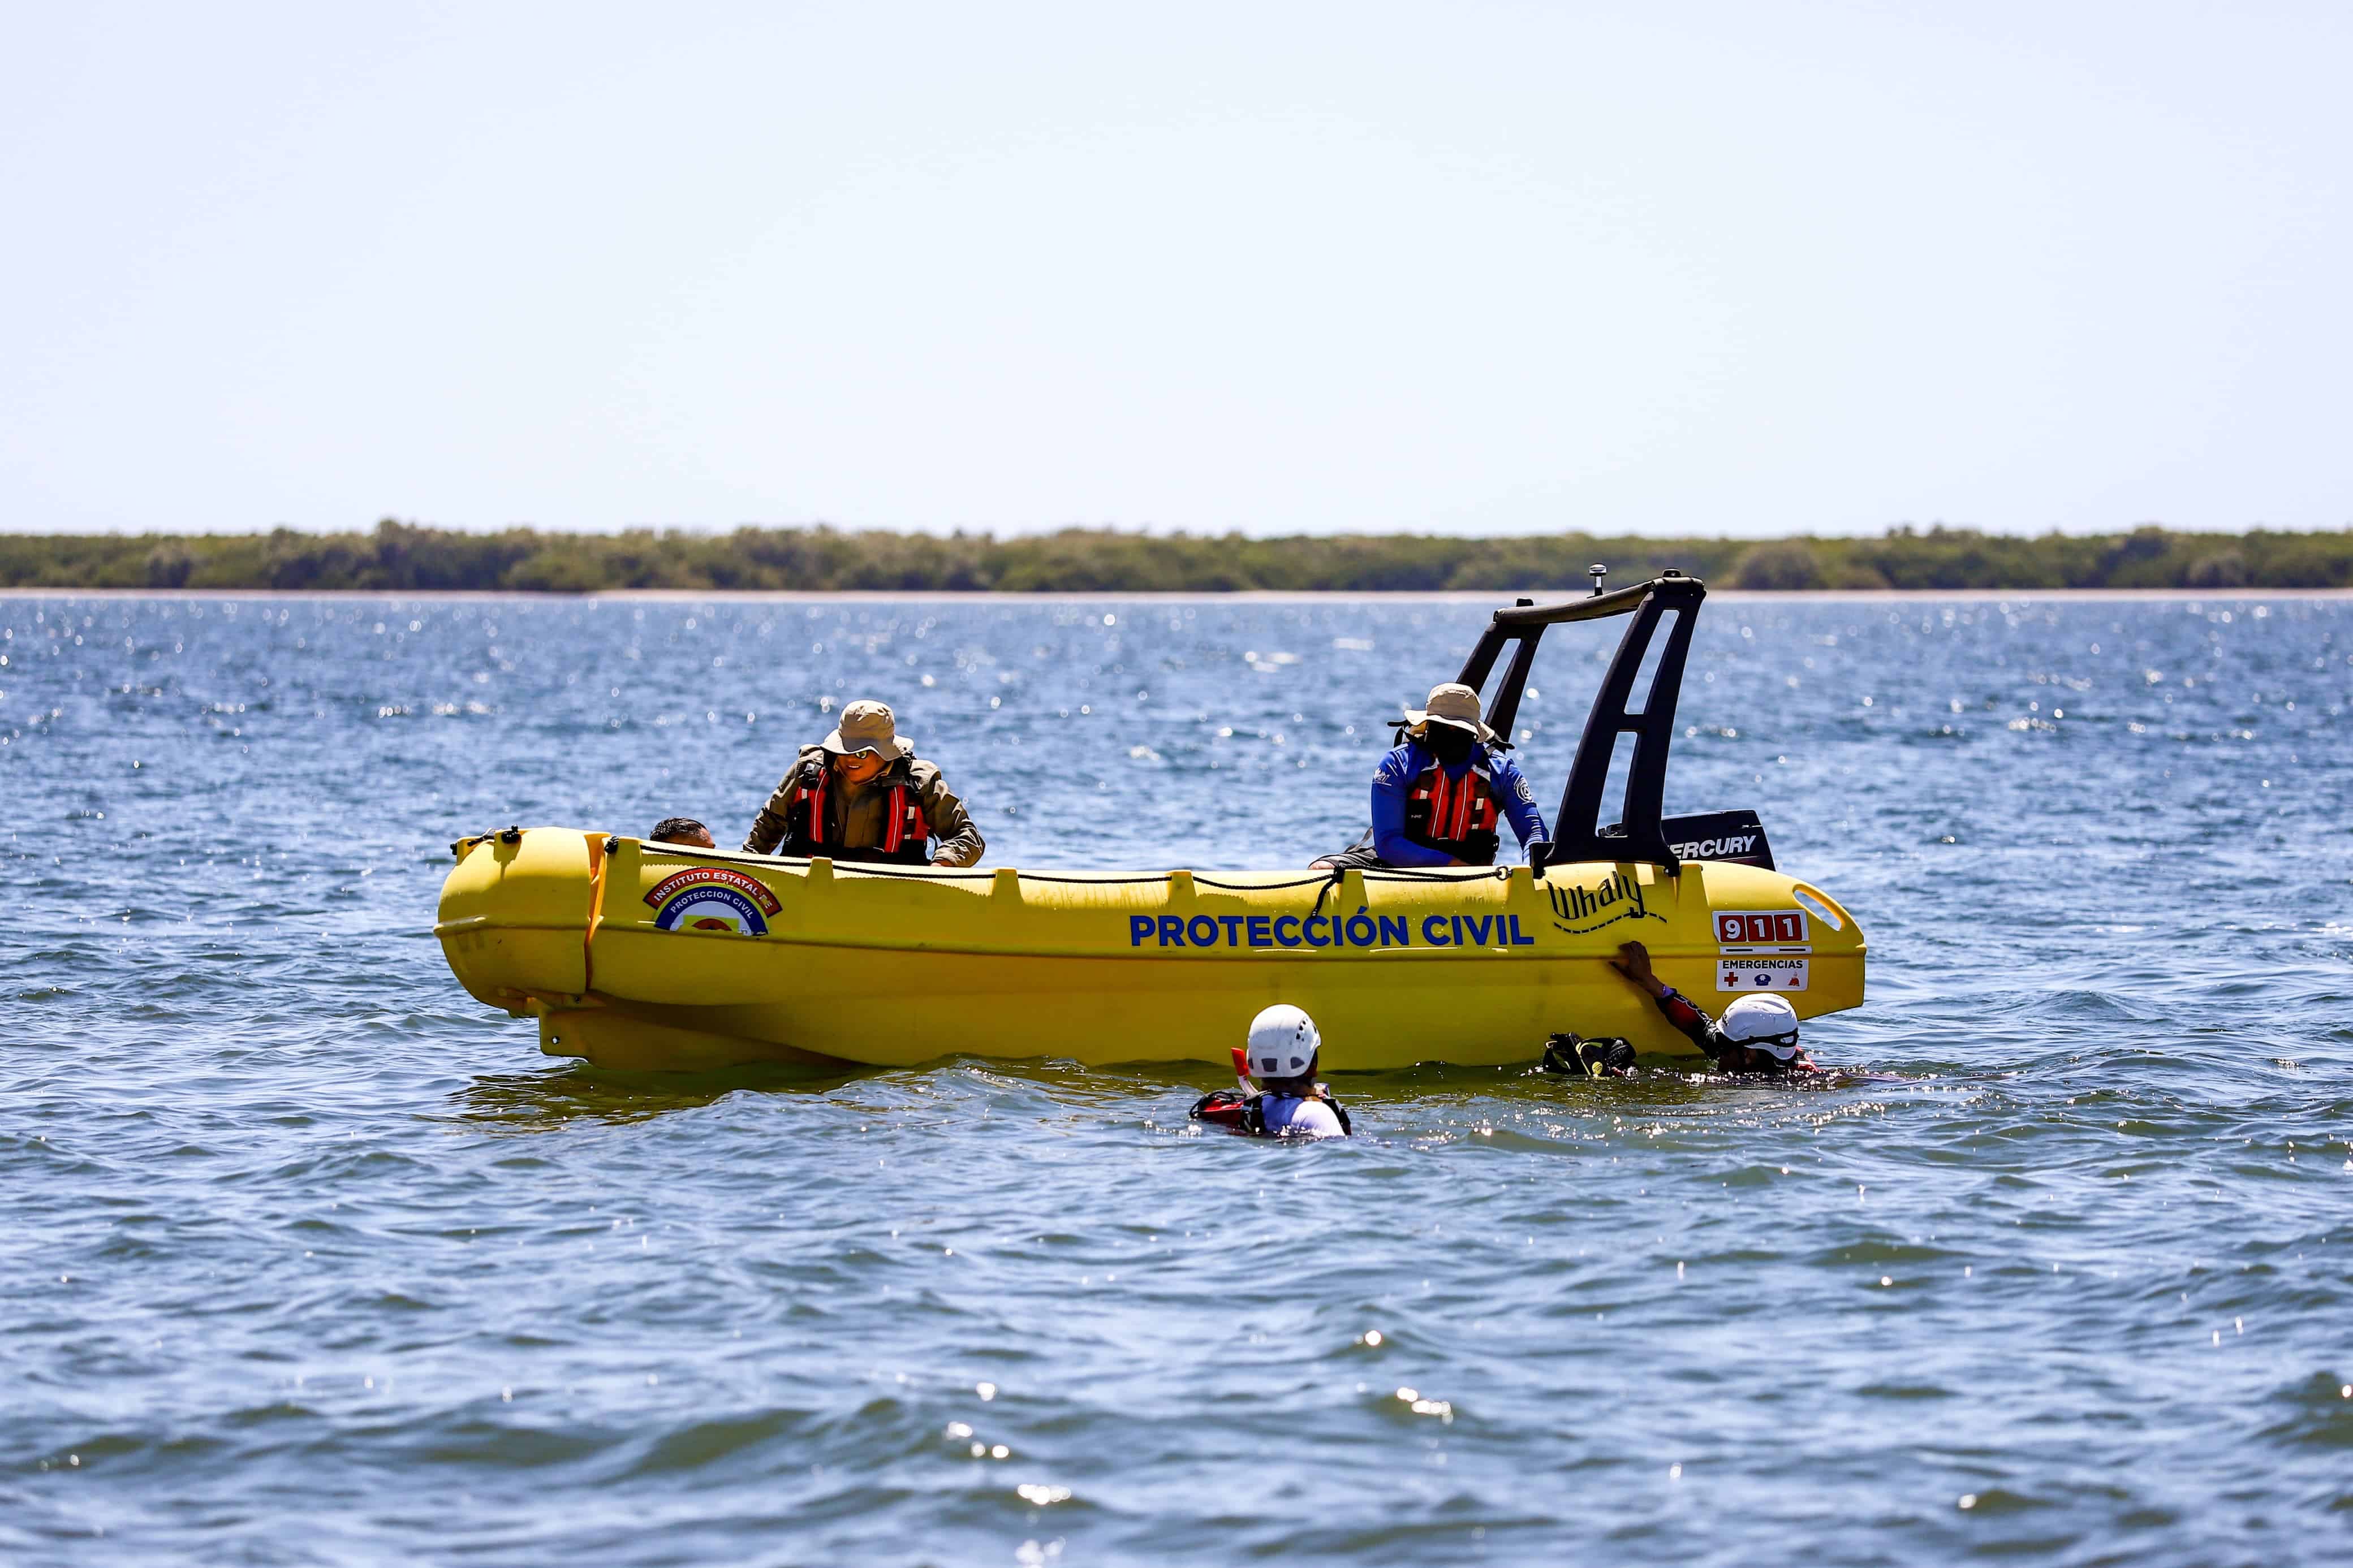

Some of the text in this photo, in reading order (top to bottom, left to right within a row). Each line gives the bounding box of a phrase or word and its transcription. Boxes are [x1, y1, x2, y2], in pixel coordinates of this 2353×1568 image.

[1670, 835, 1756, 859] ERCURY
[654, 872, 710, 901] INSTITUTO
[713, 872, 759, 896] ESTATAL
[670, 891, 753, 919] PROTECCION CIVIL
[1130, 906, 1534, 947] PROTECCIÓN CIVIL
[1725, 918, 1793, 939] 911
[1722, 960, 1803, 969] EMERGENCIAS
